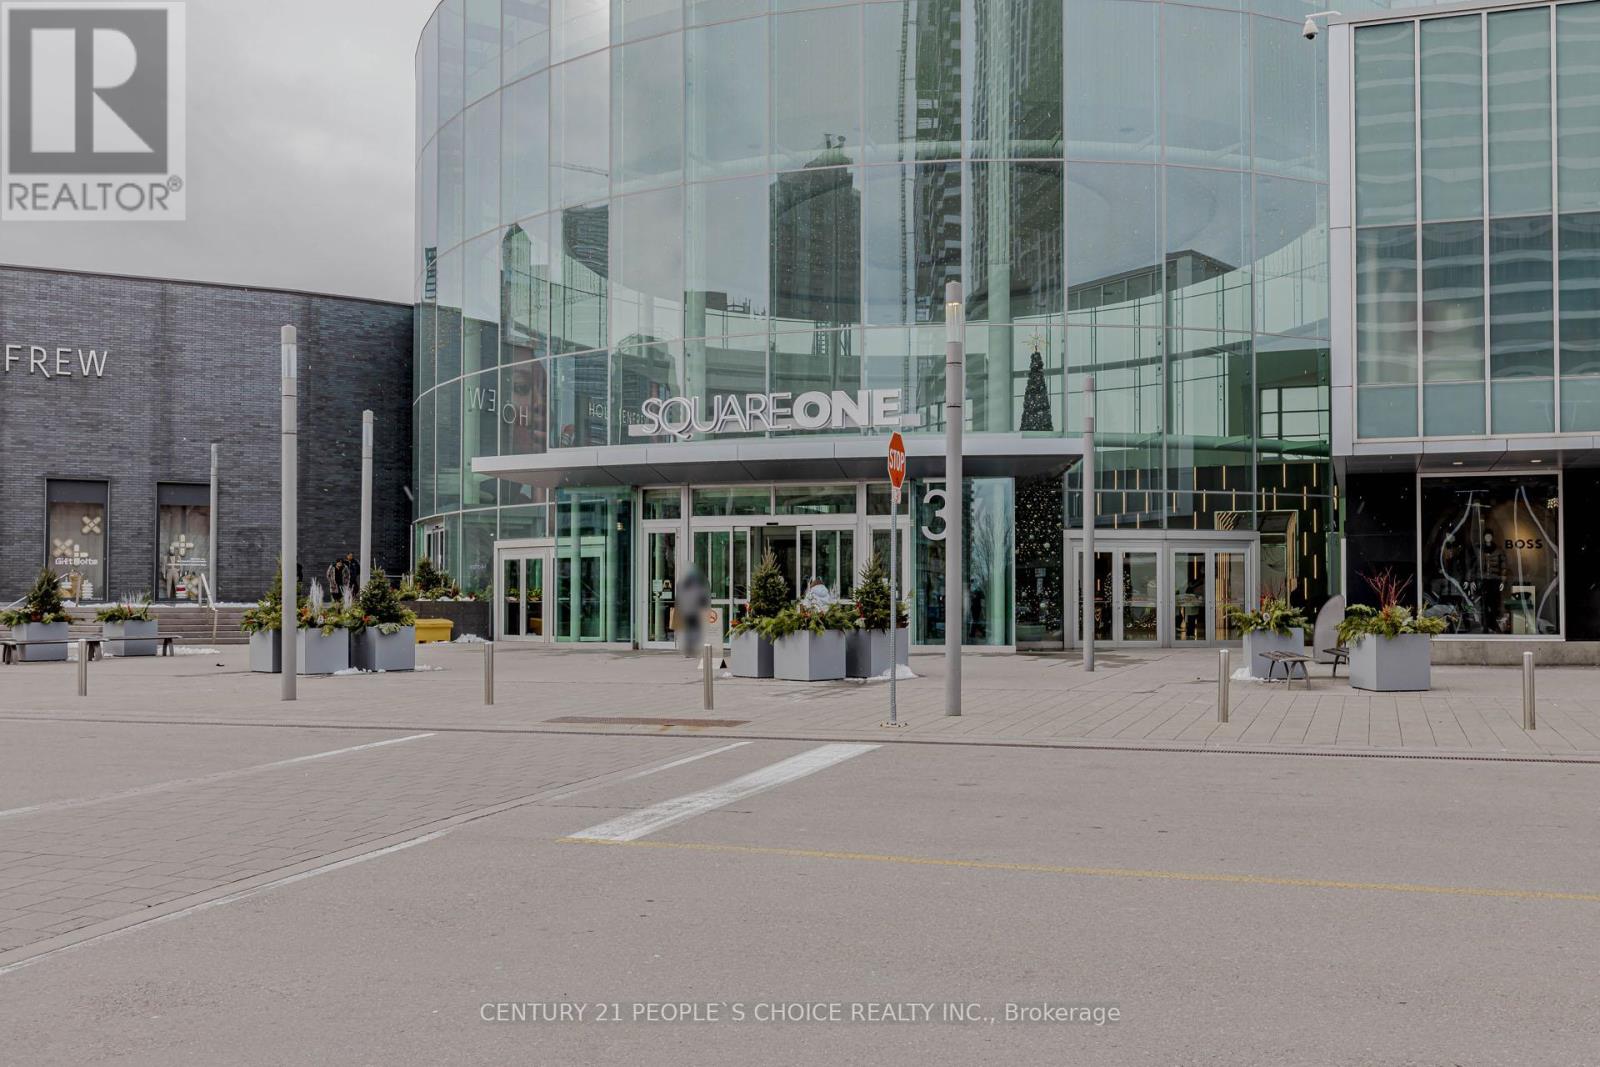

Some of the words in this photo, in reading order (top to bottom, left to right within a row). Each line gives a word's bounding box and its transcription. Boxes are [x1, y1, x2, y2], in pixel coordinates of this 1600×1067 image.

[5, 344, 108, 378] FREW
[889, 448, 905, 473] STOP
[921, 489, 947, 541] 3
[1505, 539, 1543, 549] BOSS
